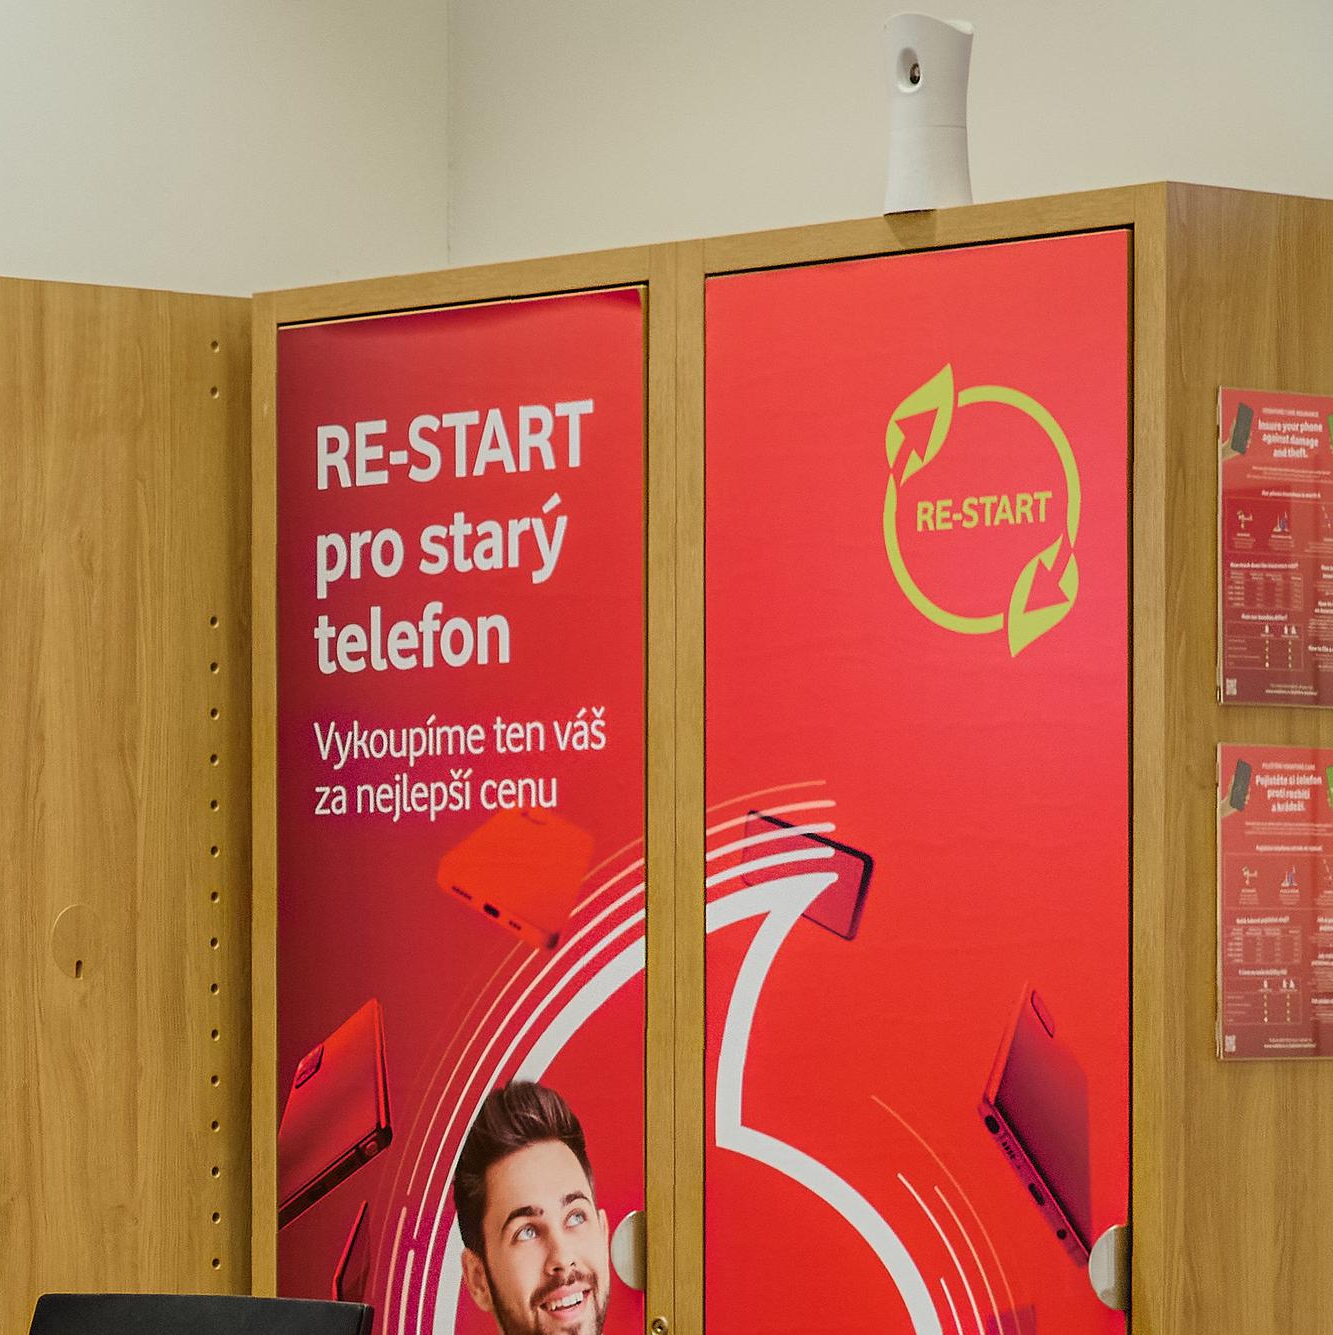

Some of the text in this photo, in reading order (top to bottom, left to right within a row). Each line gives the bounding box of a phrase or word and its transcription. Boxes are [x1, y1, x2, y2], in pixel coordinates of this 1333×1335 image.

[316, 398, 594, 491] RE-START
[916, 490, 1053, 532] RE-START
[316, 492, 568, 600] pro starý
[313, 600, 511, 675] telefon
[312, 706, 607, 770] Vykoupíme ten váš
[314, 768, 558, 823] za nejlepší cenu
